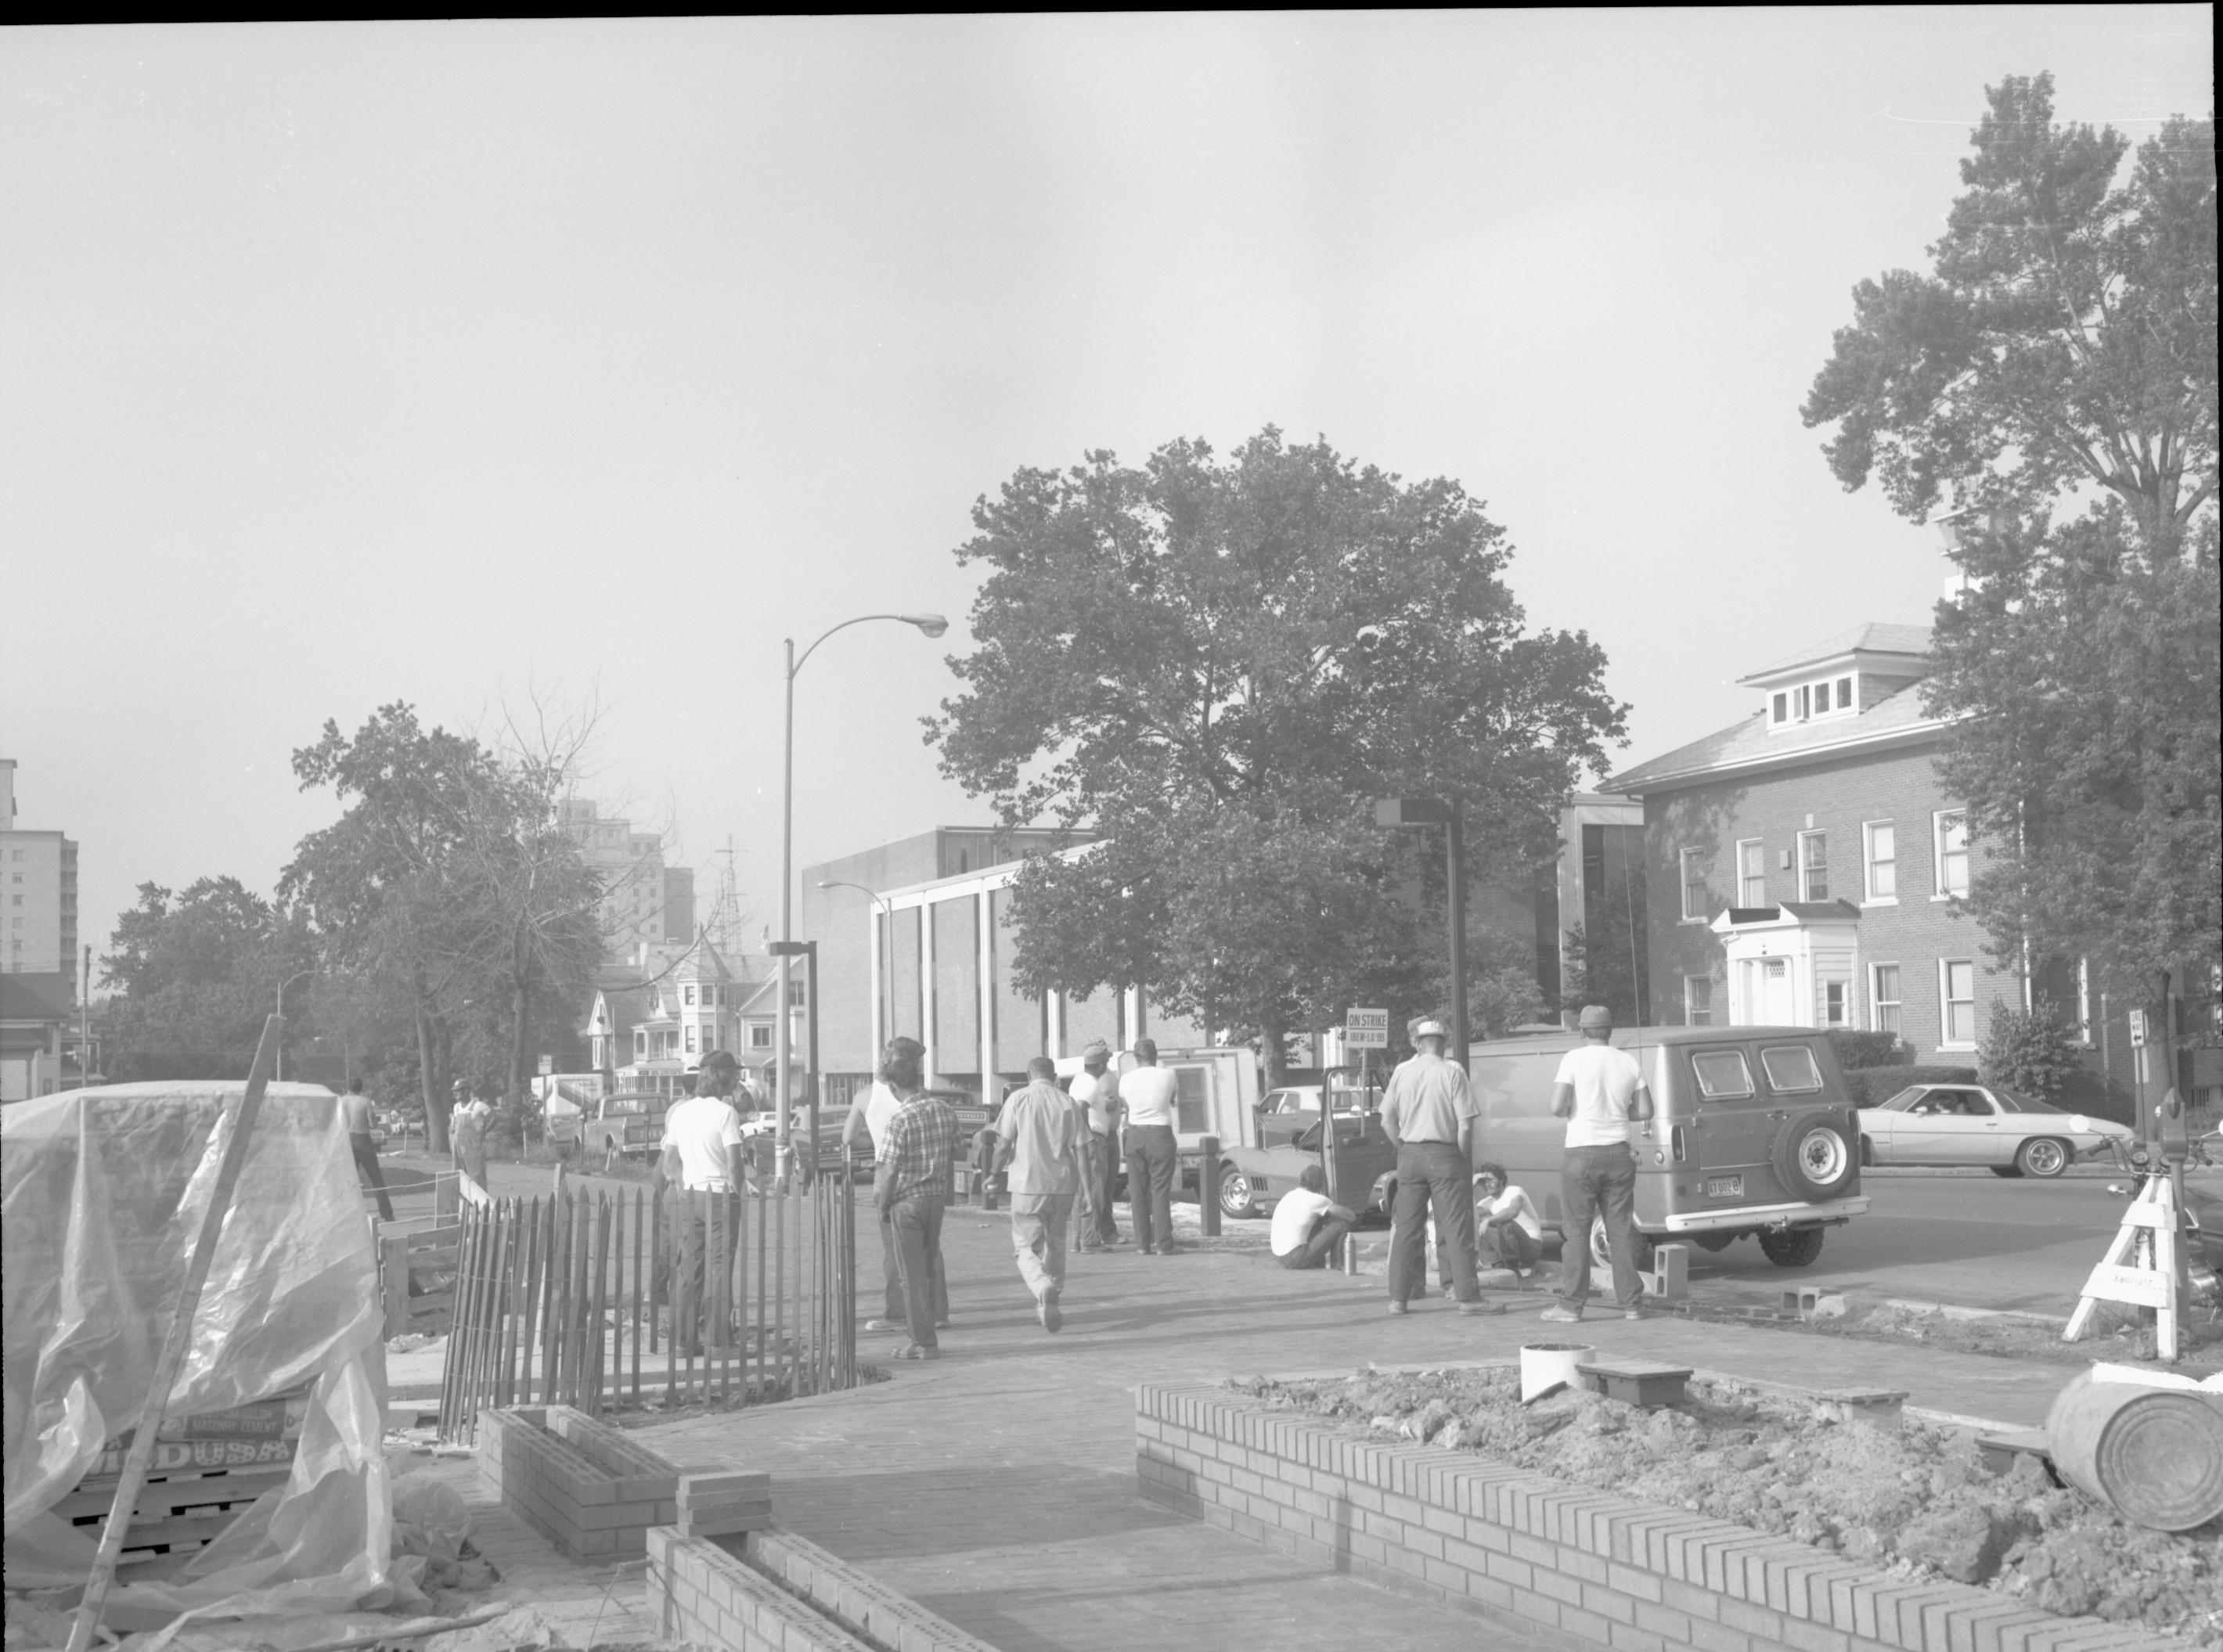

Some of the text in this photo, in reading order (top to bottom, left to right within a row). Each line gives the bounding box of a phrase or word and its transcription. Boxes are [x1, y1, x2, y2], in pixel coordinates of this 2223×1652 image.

[1349, 1013, 1386, 1027] ON STRIKE
[193, 1419, 237, 1431] MASONRY
[240, 1421, 276, 1434] CEMENT
[88, 1440, 290, 1474] MDUSA
